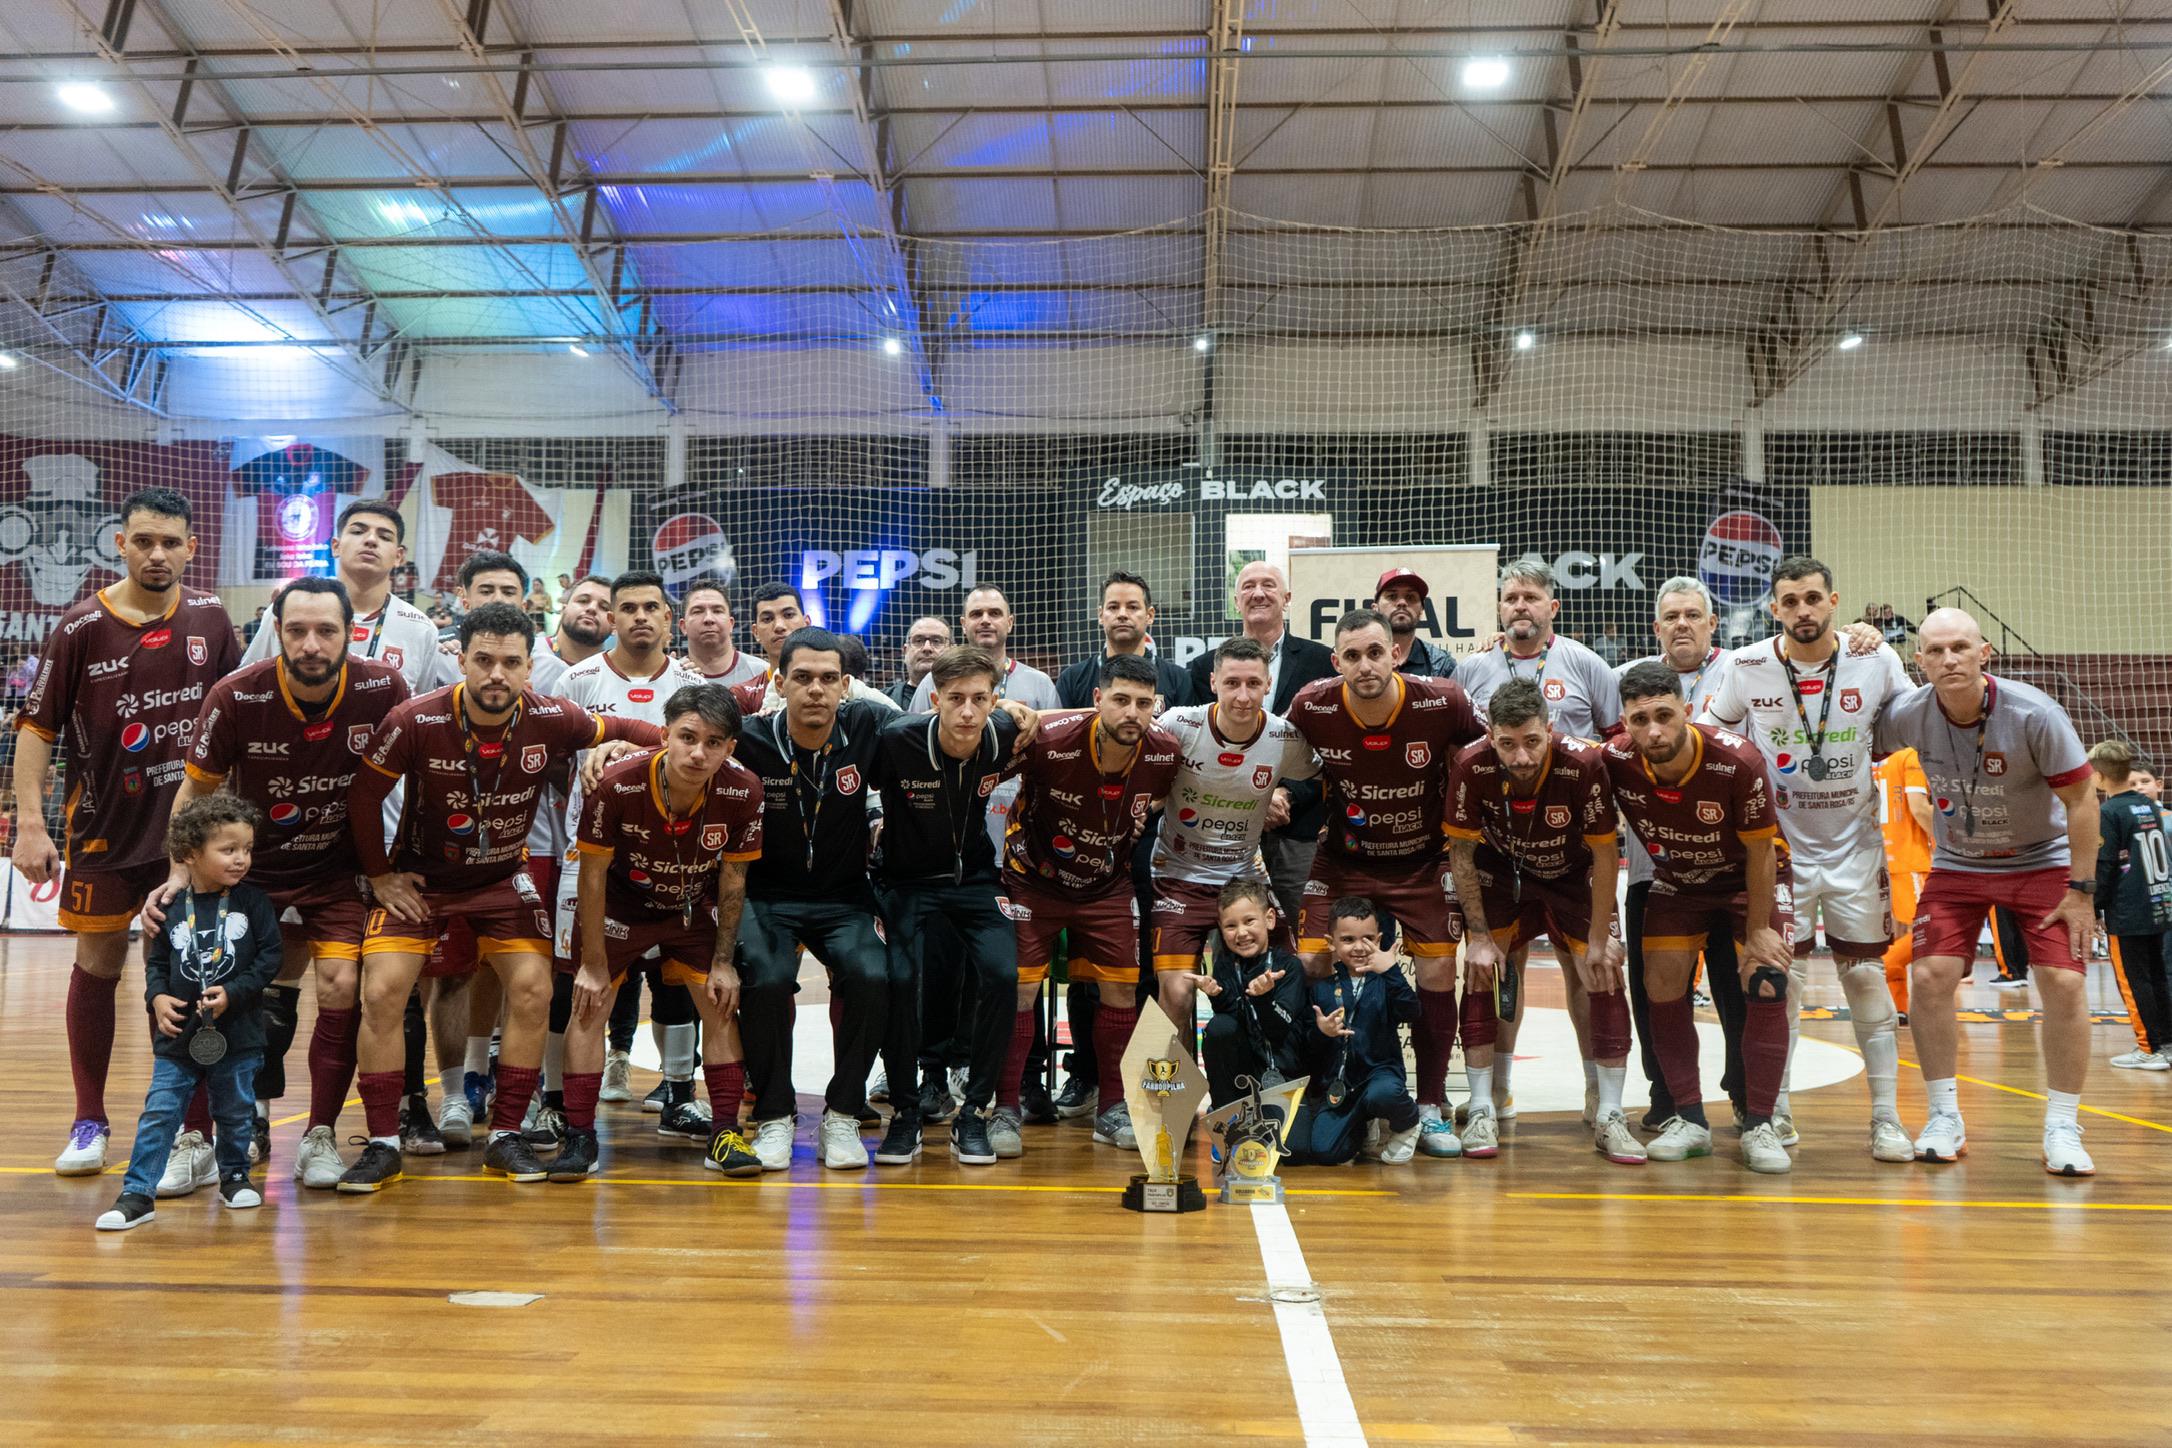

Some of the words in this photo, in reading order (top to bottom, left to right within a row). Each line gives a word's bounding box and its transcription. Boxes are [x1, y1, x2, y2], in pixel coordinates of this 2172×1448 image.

[1098, 477, 1187, 510] Espaço
[1201, 480, 1326, 499] BLACK
[802, 549, 977, 590] PEPSI
[187, 596, 222, 606] sulnet
[191, 645, 204, 661] SR
[88, 656, 129, 676] ZUK
[386, 654, 400, 667] SR
[354, 675, 392, 690] sulnet
[143, 682, 203, 710] Sicredi
[1547, 684, 1562, 699] SR
[1412, 696, 1448, 709] sulnet
[1751, 697, 1784, 707] ZUK
[1843, 695, 1858, 710] SR
[528, 705, 563, 716] sulnet
[354, 732, 369, 750] SR
[1268, 730, 1299, 739] sulnet
[248, 742, 289, 754] ZUK
[1320, 747, 1352, 760] ZUK
[528, 752, 542, 767] SR
[1144, 752, 1175, 762] sulnet
[1411, 750, 1425, 764] SR
[1801, 754, 1854, 773] ppsi
[429, 758, 467, 771] ZUK
[1705, 762, 1737, 774] sulnet
[1987, 759, 2003, 773] SR
[153, 775, 164, 787] DE
[761, 776, 793, 786] Sicredi
[841, 774, 855, 791] SR
[911, 779, 941, 789] Sicredi
[1256, 772, 1268, 786] SR
[716, 786, 750, 798] sulnet
[983, 780, 994, 794] SR
[1361, 781, 1425, 800] Sicredi
[1792, 789, 1830, 799] PREFEITURA
[1831, 787, 1859, 797] MUNICIPAL
[1050, 788, 1084, 805] ZUK
[1201, 794, 1258, 811] Sicredi
[1798, 800, 1807, 809] DE
[1808, 799, 1829, 809] SANTA
[1369, 806, 1422, 828] pepsi
[1551, 812, 1565, 825] SR
[1703, 807, 1717, 821] SR
[1201, 817, 1249, 834] pepsi
[707, 832, 722, 846] SR
[1658, 827, 1721, 843] Sicredi
[1361, 840, 1399, 850] PREFEITURA
[1377, 848, 1398, 856] SANTA
[1669, 848, 1723, 861] pepsi
[2134, 829, 2169, 884] 10
[70, 880, 93, 913] 51
